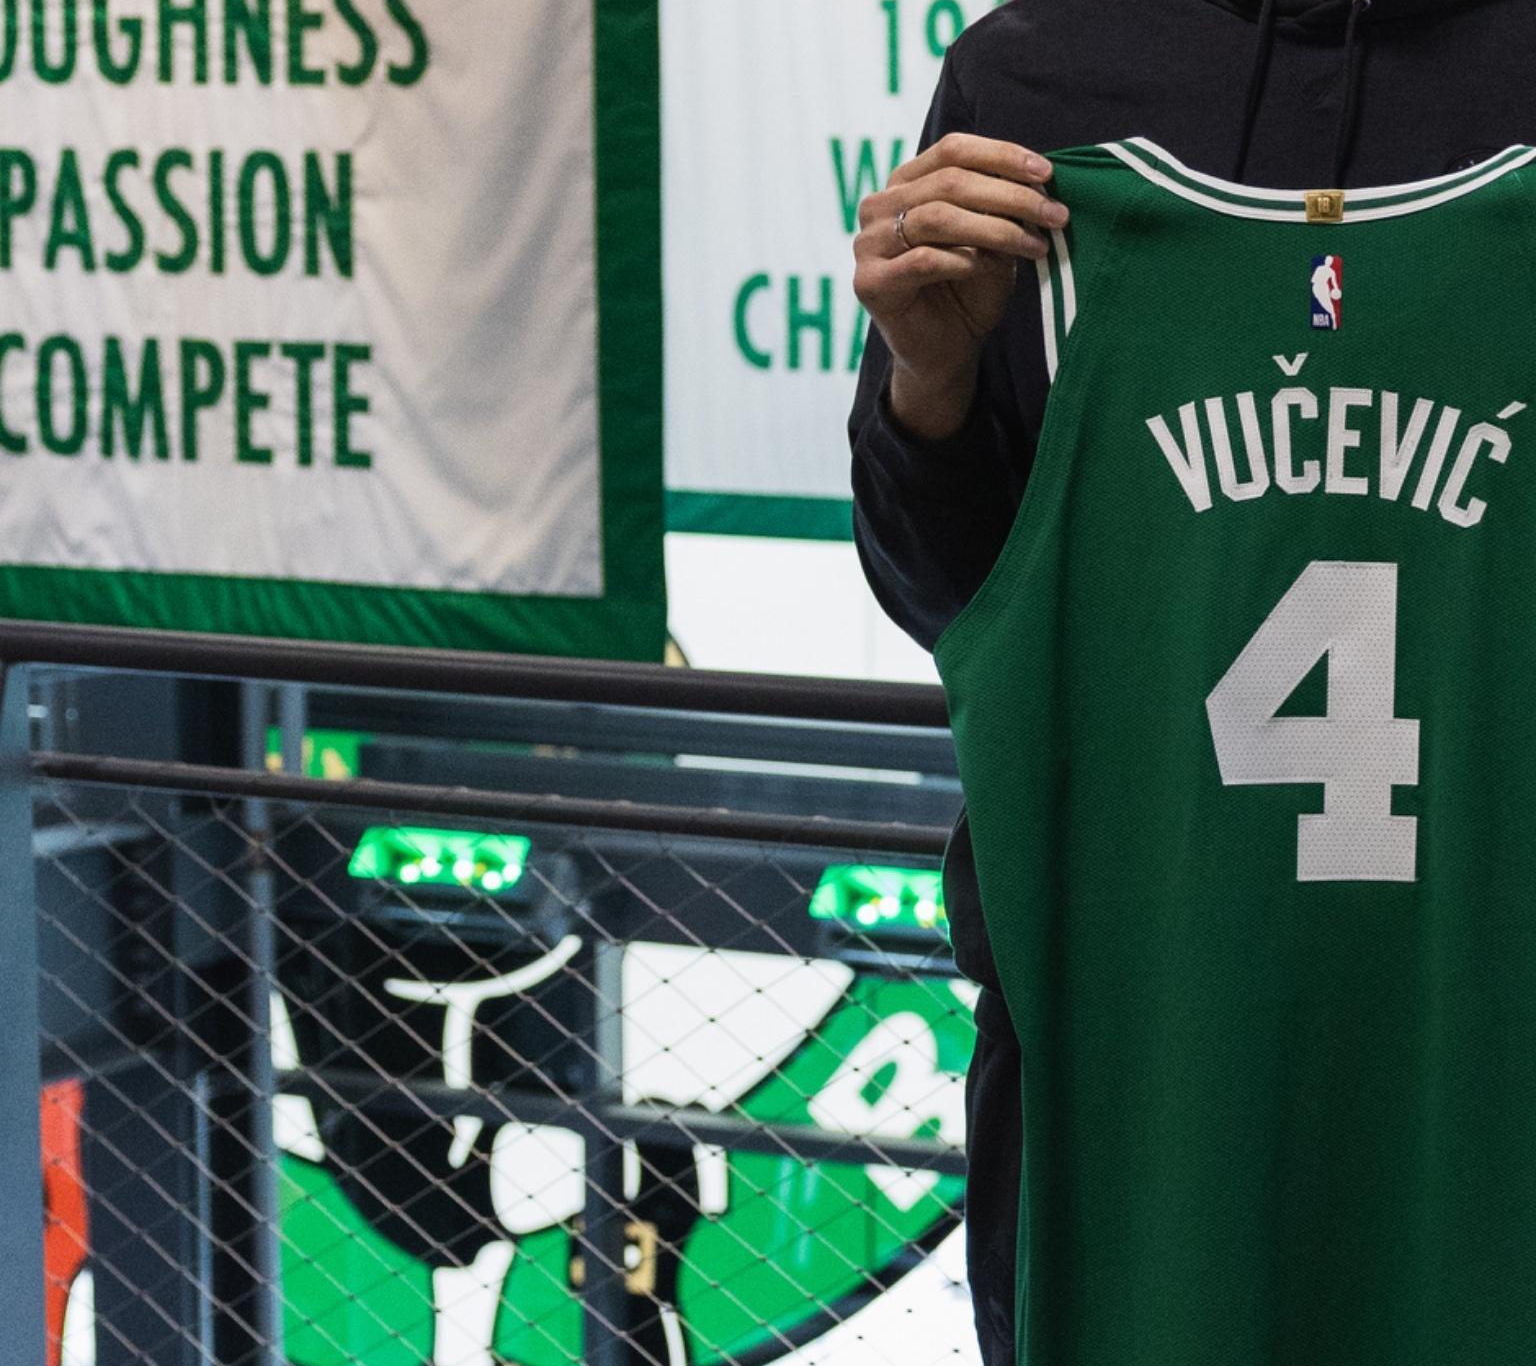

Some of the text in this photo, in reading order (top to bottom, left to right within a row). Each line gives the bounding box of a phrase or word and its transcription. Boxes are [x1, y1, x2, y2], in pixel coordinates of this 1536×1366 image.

[0, 146, 354, 278] PASSION
[1312, 313, 1331, 327] NBA
[1145, 352, 1527, 528] VUČEVIĆ
[1205, 560, 1420, 882] 4
